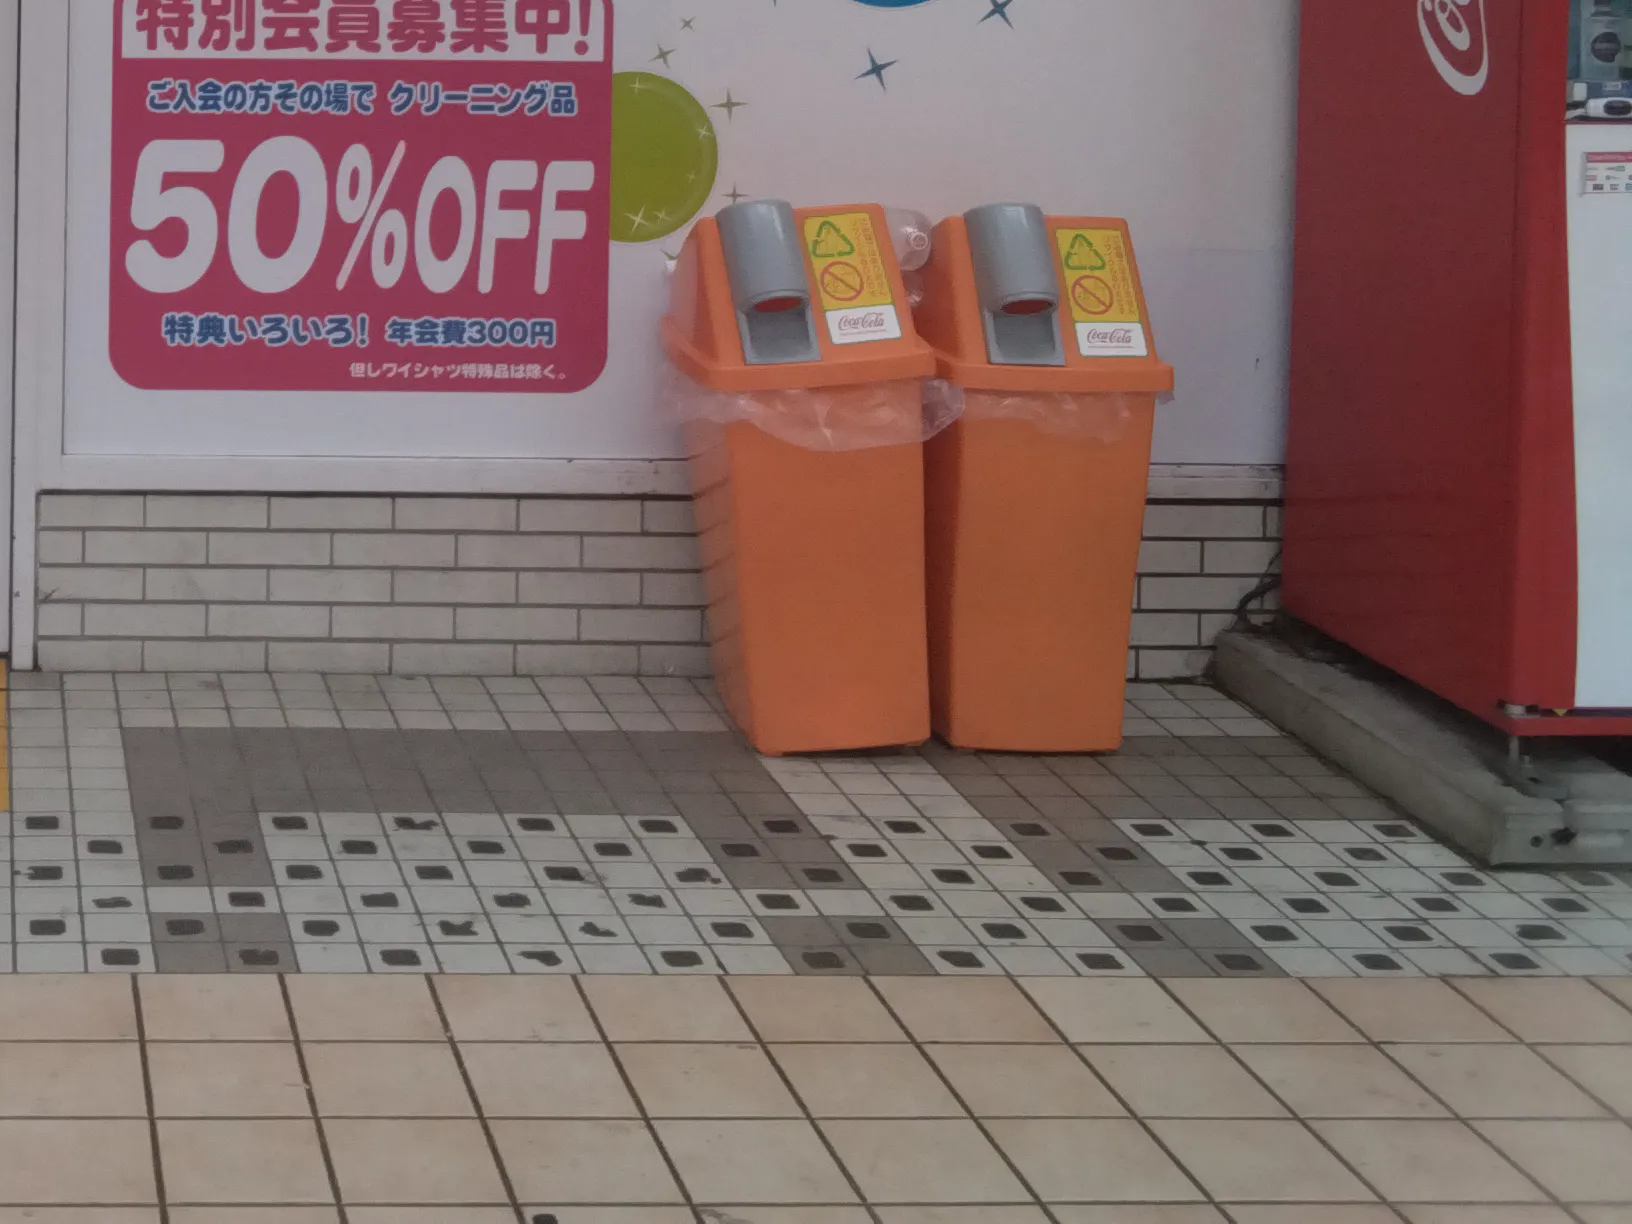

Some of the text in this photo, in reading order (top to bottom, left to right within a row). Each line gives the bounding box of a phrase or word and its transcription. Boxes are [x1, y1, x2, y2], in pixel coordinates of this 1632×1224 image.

[146, 79, 577, 116] ご入会の方その場で クリーニング品
[125, 135, 595, 295] 50%OFF
[162, 314, 557, 348] 特典いろいろ! 年会費300円
